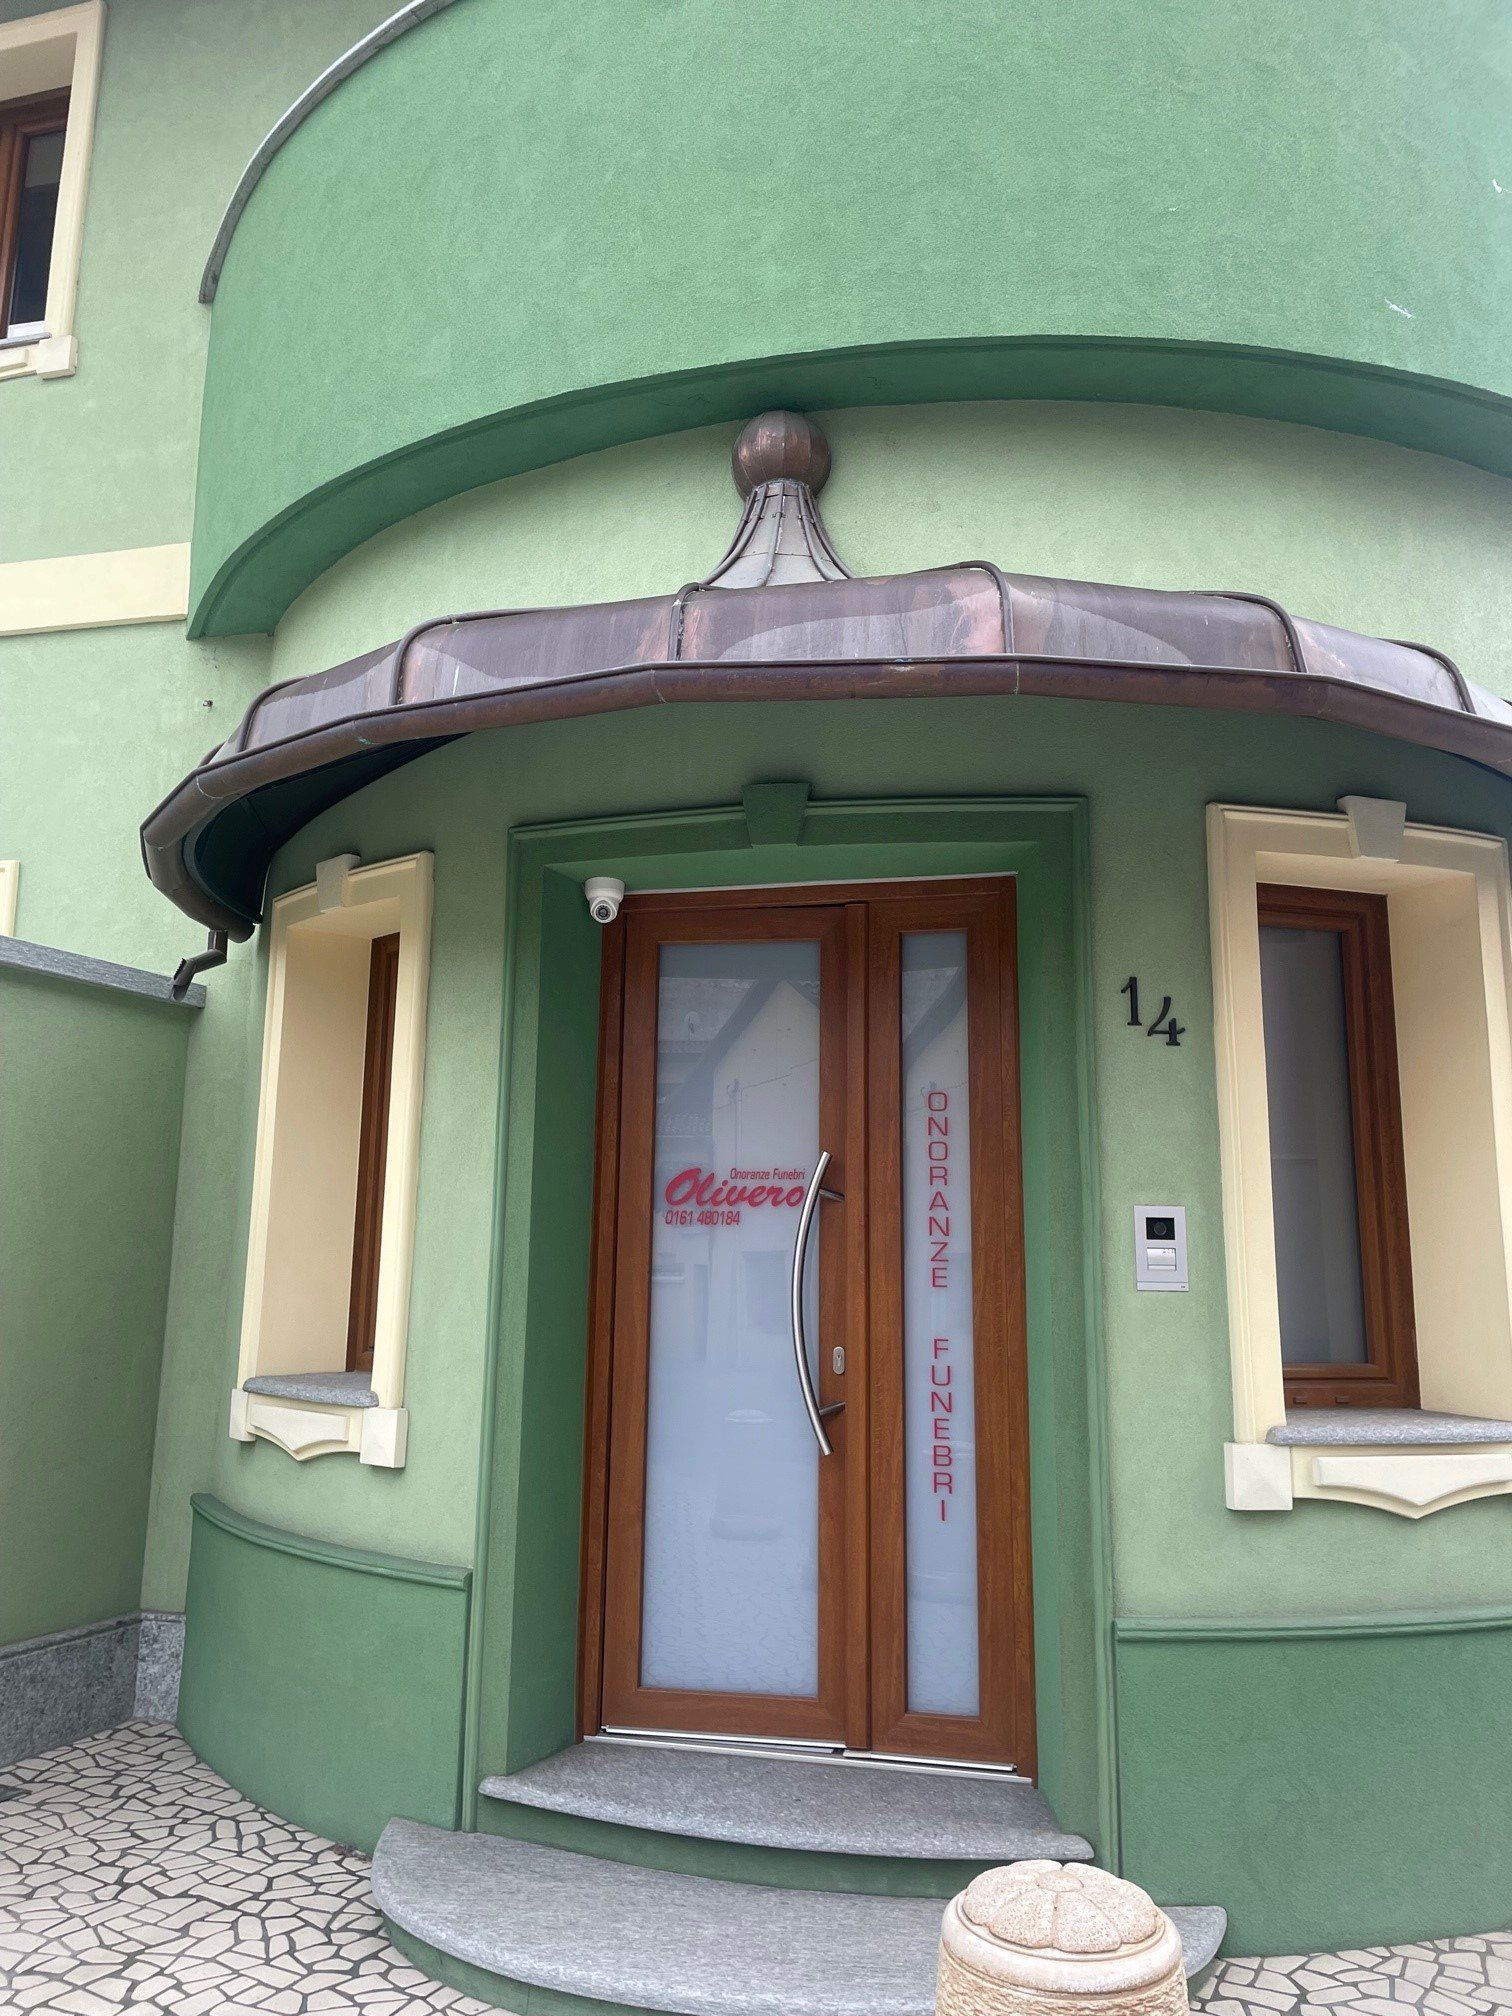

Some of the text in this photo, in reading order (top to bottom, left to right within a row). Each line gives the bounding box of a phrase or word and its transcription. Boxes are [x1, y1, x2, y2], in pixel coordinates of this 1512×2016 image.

[1121, 976, 1185, 1046] 14
[665, 1167, 805, 1208] Olivero
[730, 1168, 806, 1180] Onoranze Funebri
[665, 1210, 740, 1226] 0161 480184
[928, 1092, 953, 1522] ONORANZE FUNEBRI
